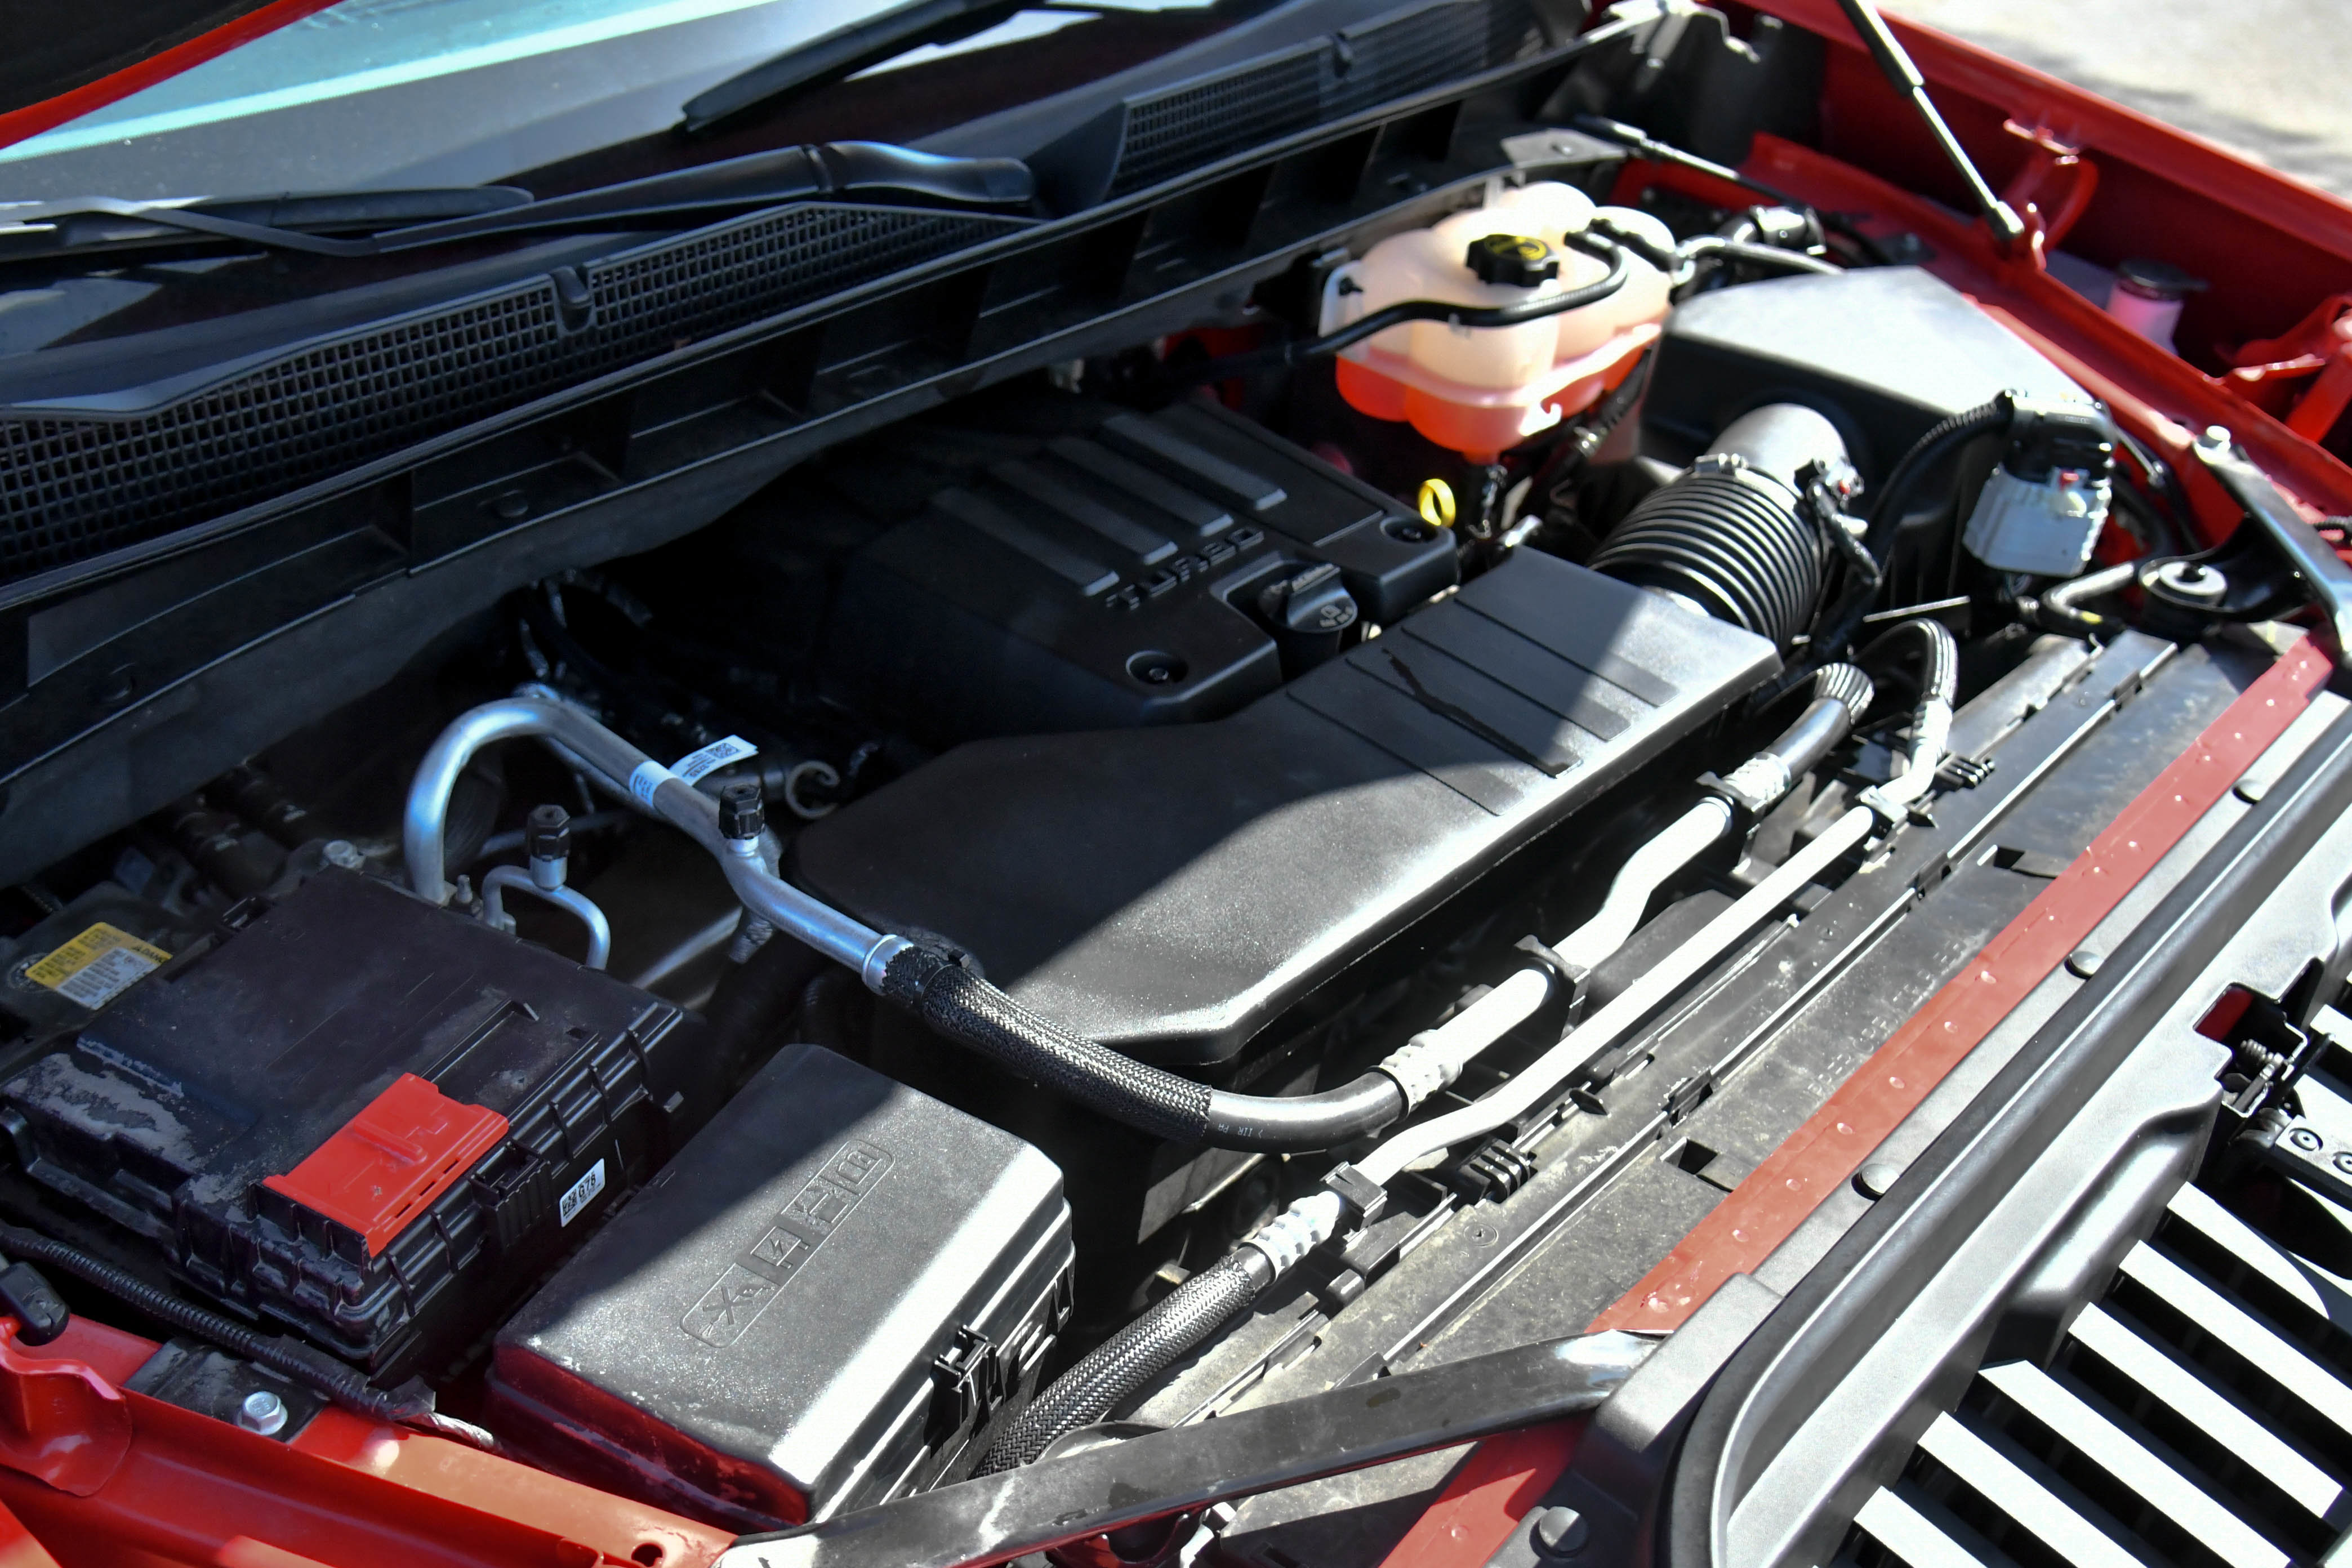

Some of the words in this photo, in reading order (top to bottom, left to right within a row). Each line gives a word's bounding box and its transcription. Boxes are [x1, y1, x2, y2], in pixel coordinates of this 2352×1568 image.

[1106, 527, 1265, 611] TURBO
[1218, 1122, 1230, 1134] PA
[1237, 1126, 1253, 1137] IIR
[578, 1174, 596, 1198] G78
